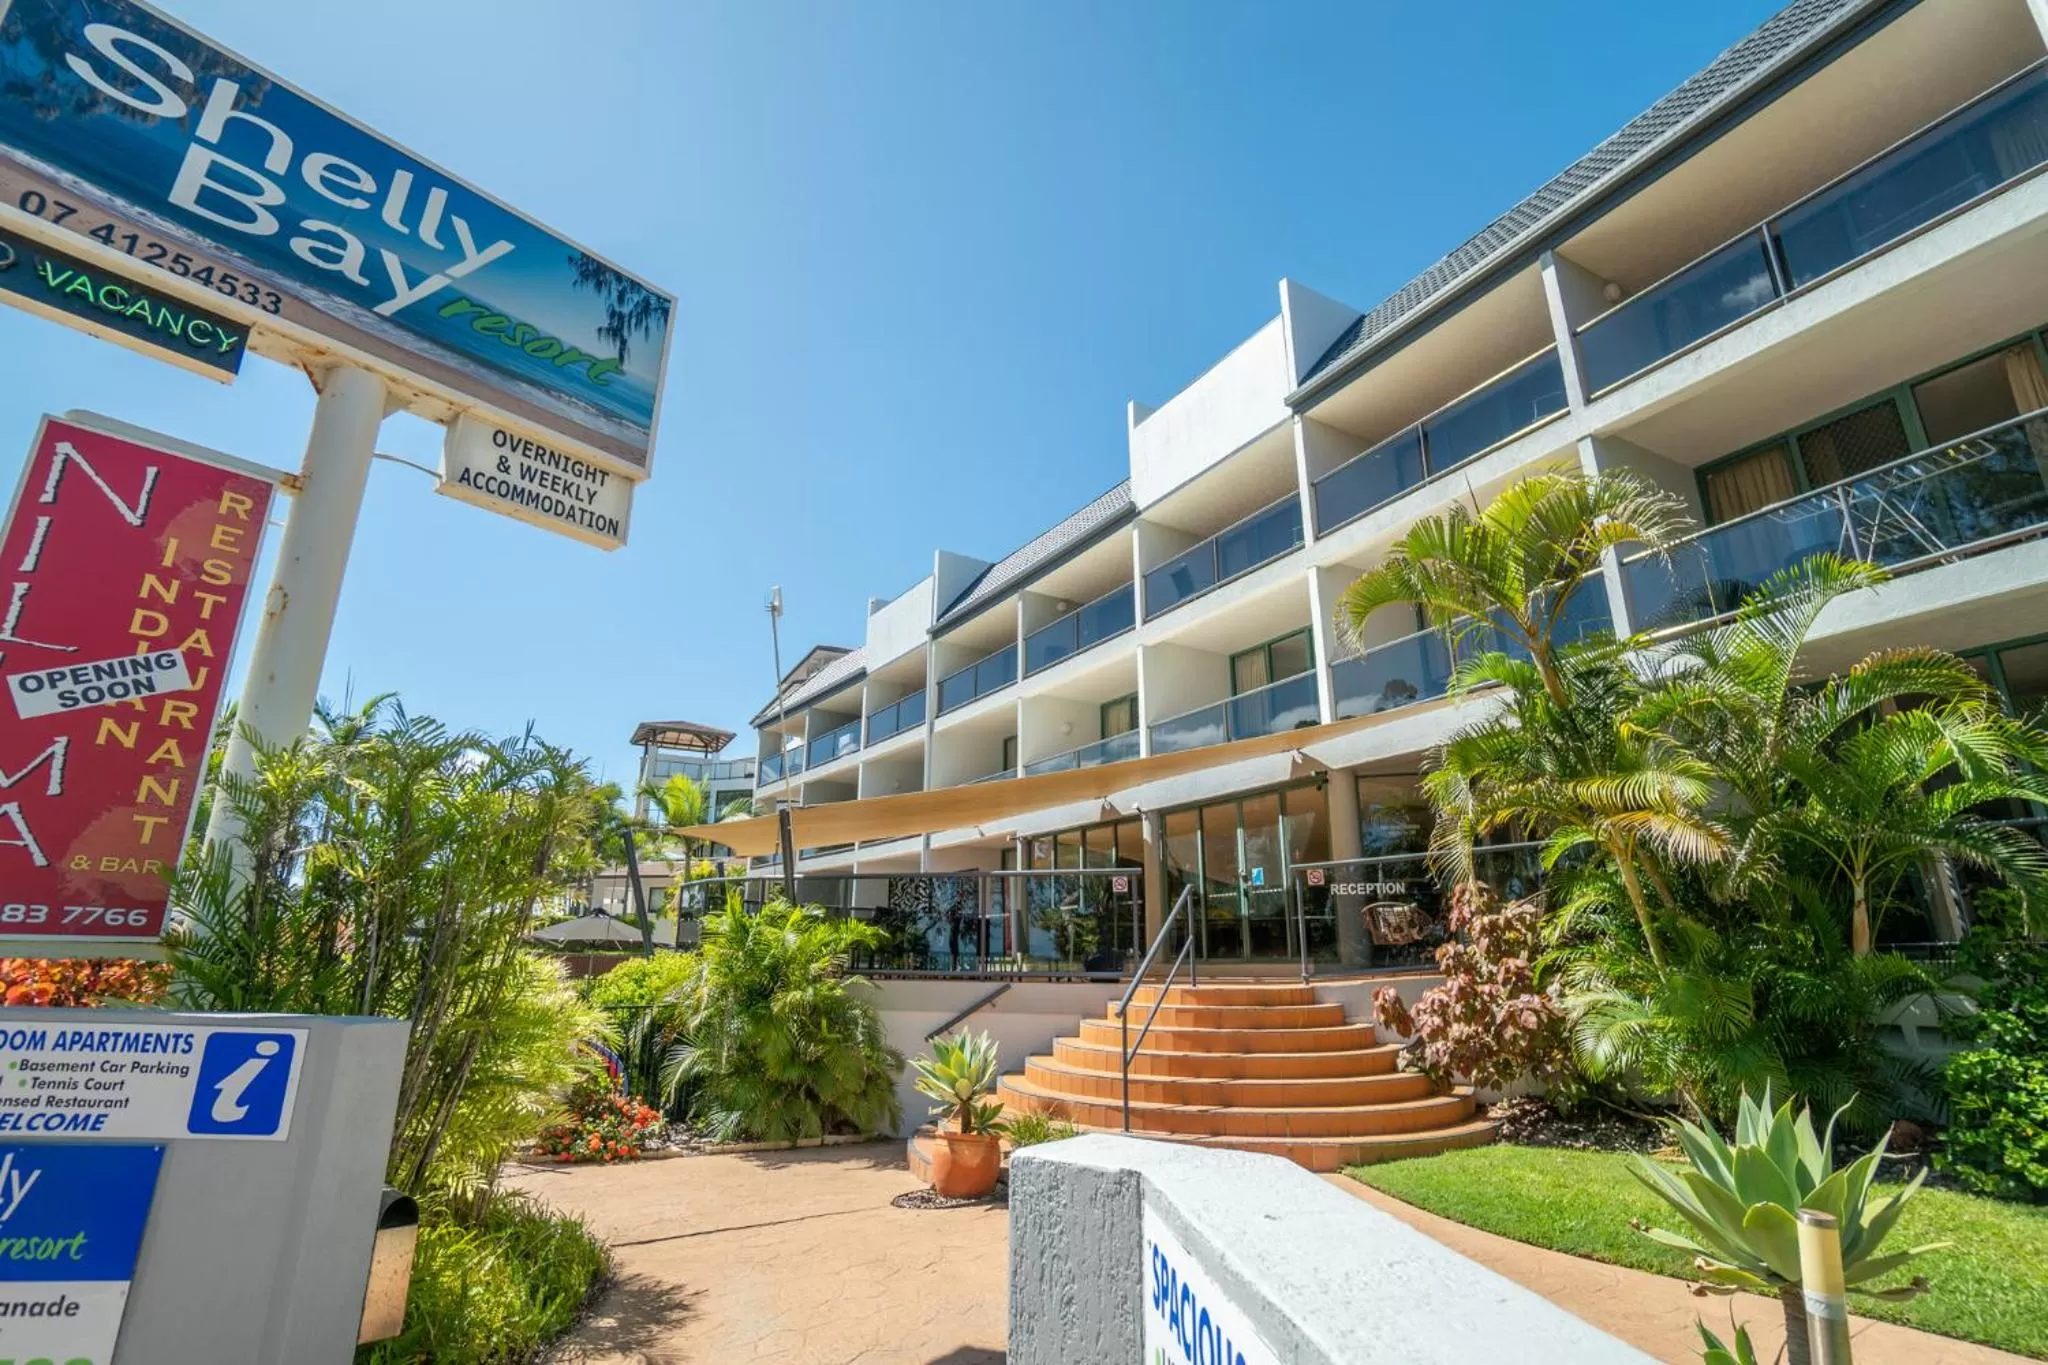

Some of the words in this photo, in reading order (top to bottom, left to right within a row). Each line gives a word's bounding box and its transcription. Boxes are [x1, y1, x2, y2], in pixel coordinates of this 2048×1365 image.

[65, 23, 516, 278] Shelly
[168, 142, 452, 317] Bay
[19, 189, 78, 224] 07
[90, 223, 283, 315] 41254533
[45, 261, 238, 352] VACANCY
[438, 297, 626, 386] resort
[492, 430, 610, 487] OVERNIGHT
[496, 455, 511, 475] &
[519, 462, 598, 505] WEEKLY
[459, 467, 620, 536] ACCOMMODATION
[18, 653, 178, 693] OPENING
[57, 676, 157, 708] SOON
[70, 855, 92, 870] &
[99, 856, 162, 874] BAR
[1330, 882, 1406, 896] RECEPTION
[0, 904, 48, 923] 83
[61, 906, 149, 926] 7766
[51, 1030, 195, 1055] APARTMENTS
[19, 1059, 97, 1073] Basement
[100, 1060, 127, 1073] Car
[130, 1061, 190, 1078] Parking
[31, 1076, 80, 1090] Tennis
[84, 1078, 126, 1091] Court
[0, 1095, 42, 1107] nsed
[45, 1096, 130, 1109] Restaurant
[0, 1231, 88, 1260] resort
[1153, 1243, 1246, 1365] SPACIO
